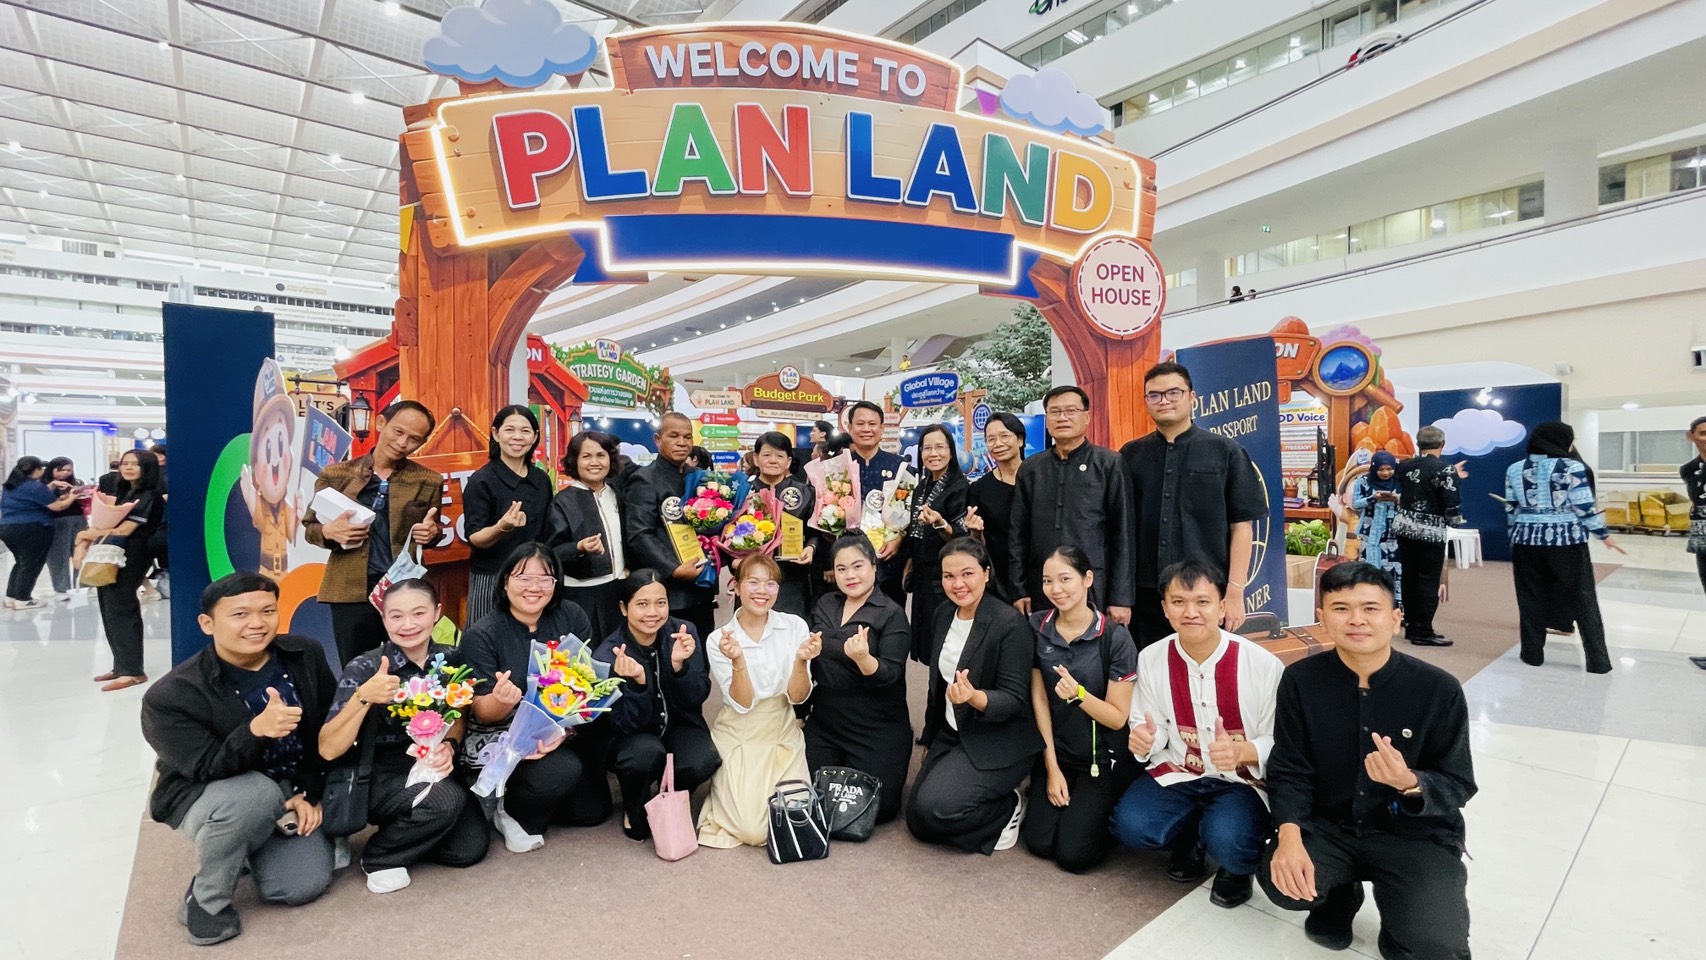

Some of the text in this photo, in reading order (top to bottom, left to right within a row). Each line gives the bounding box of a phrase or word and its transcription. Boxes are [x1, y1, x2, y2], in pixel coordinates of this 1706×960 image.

[645, 41, 927, 97] WELCOME TO
[492, 103, 1115, 235] PLAN LAND
[1096, 263, 1144, 283] OPEN
[1091, 287, 1152, 306] HOUSE
[599, 341, 616, 351] PLAN
[601, 350, 618, 360] LAND
[569, 363, 647, 391] STRATEGY GARDEN
[782, 370, 798, 378] PLAN
[904, 376, 955, 392] Global Village
[753, 387, 825, 403] Budget Park
[1191, 381, 1272, 420] PLAN LAND
[299, 399, 334, 410] LT'S
[829, 782, 863, 796] PRADA
